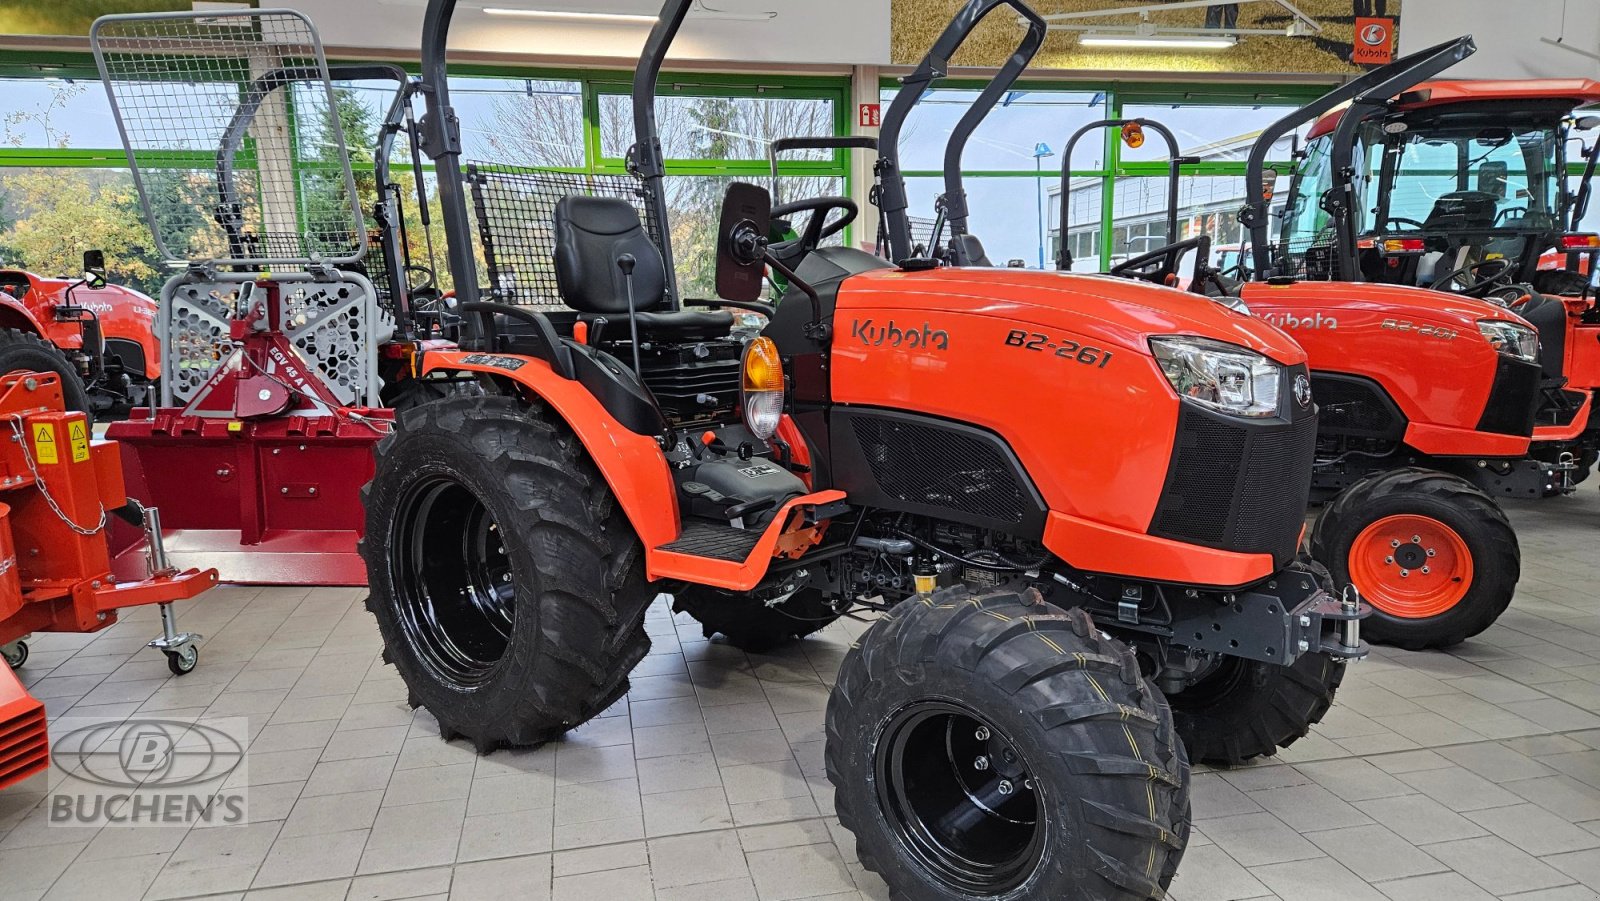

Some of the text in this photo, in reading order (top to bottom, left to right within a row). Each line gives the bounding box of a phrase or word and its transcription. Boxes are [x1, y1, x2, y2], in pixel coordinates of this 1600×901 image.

[1357, 48, 1388, 58] Kubota
[81, 302, 113, 312] Kubota
[852, 319, 949, 350] Kubota
[1005, 329, 1114, 369] B2-261
[269, 346, 305, 387] EGV 45 A
